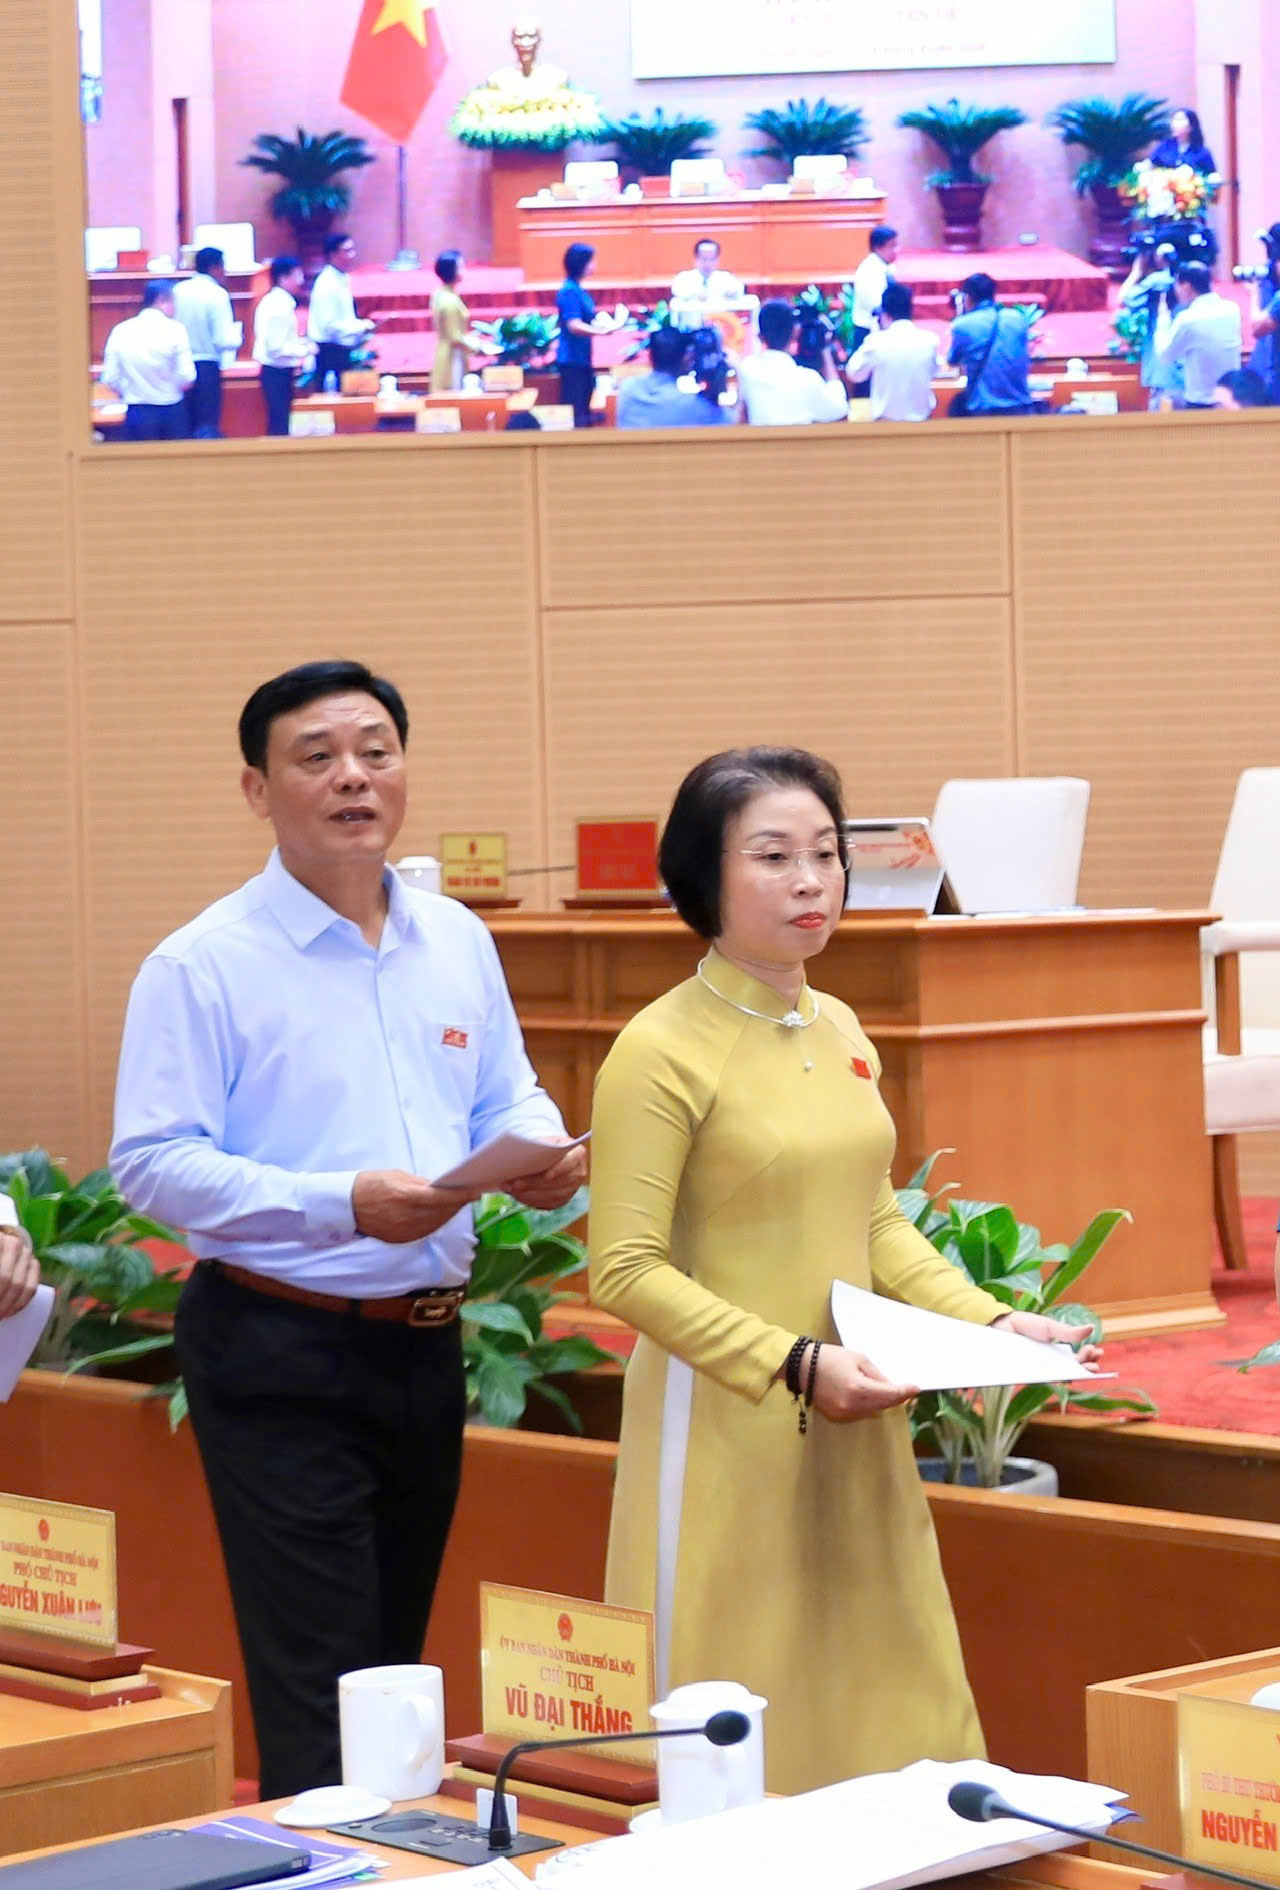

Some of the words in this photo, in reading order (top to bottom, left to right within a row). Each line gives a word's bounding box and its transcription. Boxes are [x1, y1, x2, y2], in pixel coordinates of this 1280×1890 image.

[55, 1569, 77, 1587] TỊCH
[0, 1580, 38, 1613] GUYỄN
[565, 1650, 591, 1667] THÀNH
[591, 1651, 608, 1670] PHỐ
[608, 1657, 621, 1673] HÀ
[620, 1660, 636, 1677] NỘI
[565, 1671, 594, 1692] TỊCH
[505, 1682, 529, 1718] VŨ
[533, 1692, 565, 1731] ĐẠI
[570, 1694, 633, 1734] THẮNG
[1201, 1808, 1277, 1852] NGUYỄN
